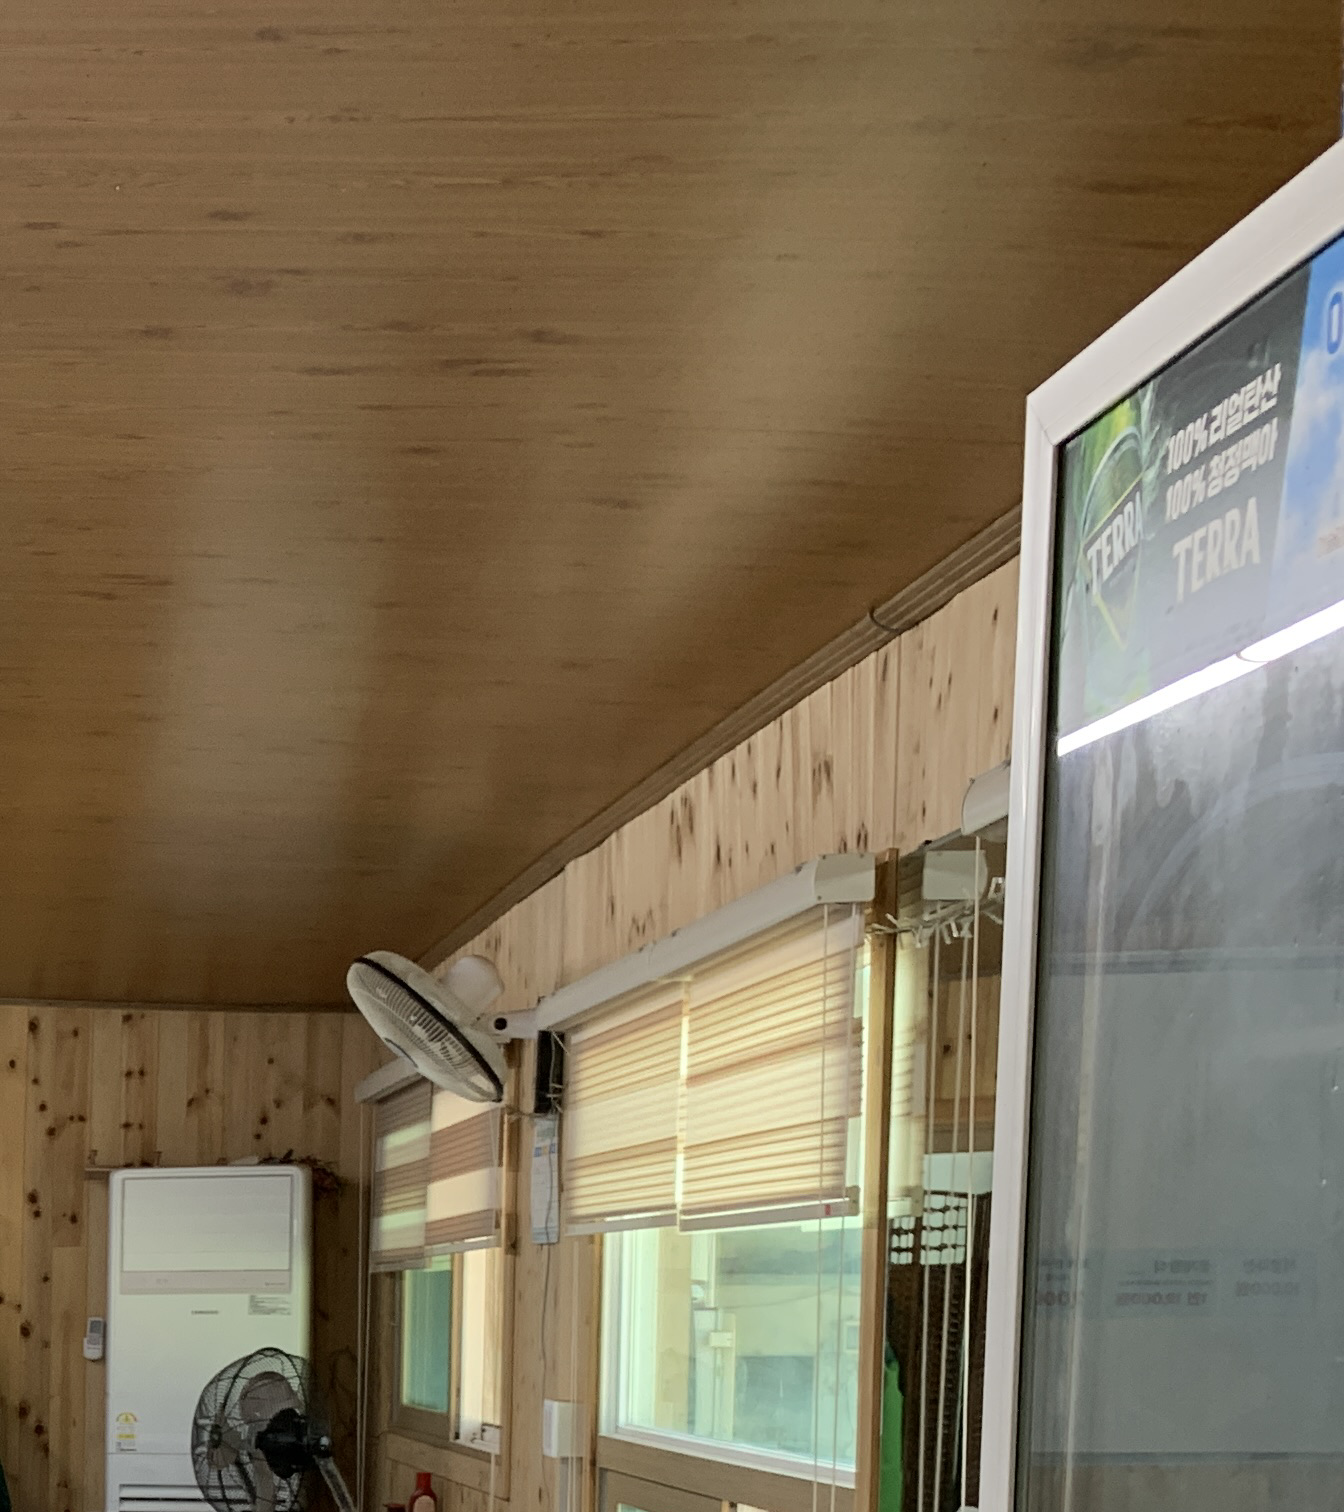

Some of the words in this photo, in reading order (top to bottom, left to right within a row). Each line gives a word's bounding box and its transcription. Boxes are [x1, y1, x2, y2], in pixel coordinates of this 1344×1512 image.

[1164, 464, 1206, 522] 100%
[1207, 416, 1278, 498] 청정맥아
[1167, 412, 1208, 475] 100%
[1209, 362, 1282, 446] 리얼탄산
[1087, 490, 1144, 601] TERRA
[1172, 496, 1260, 604] TERRA
